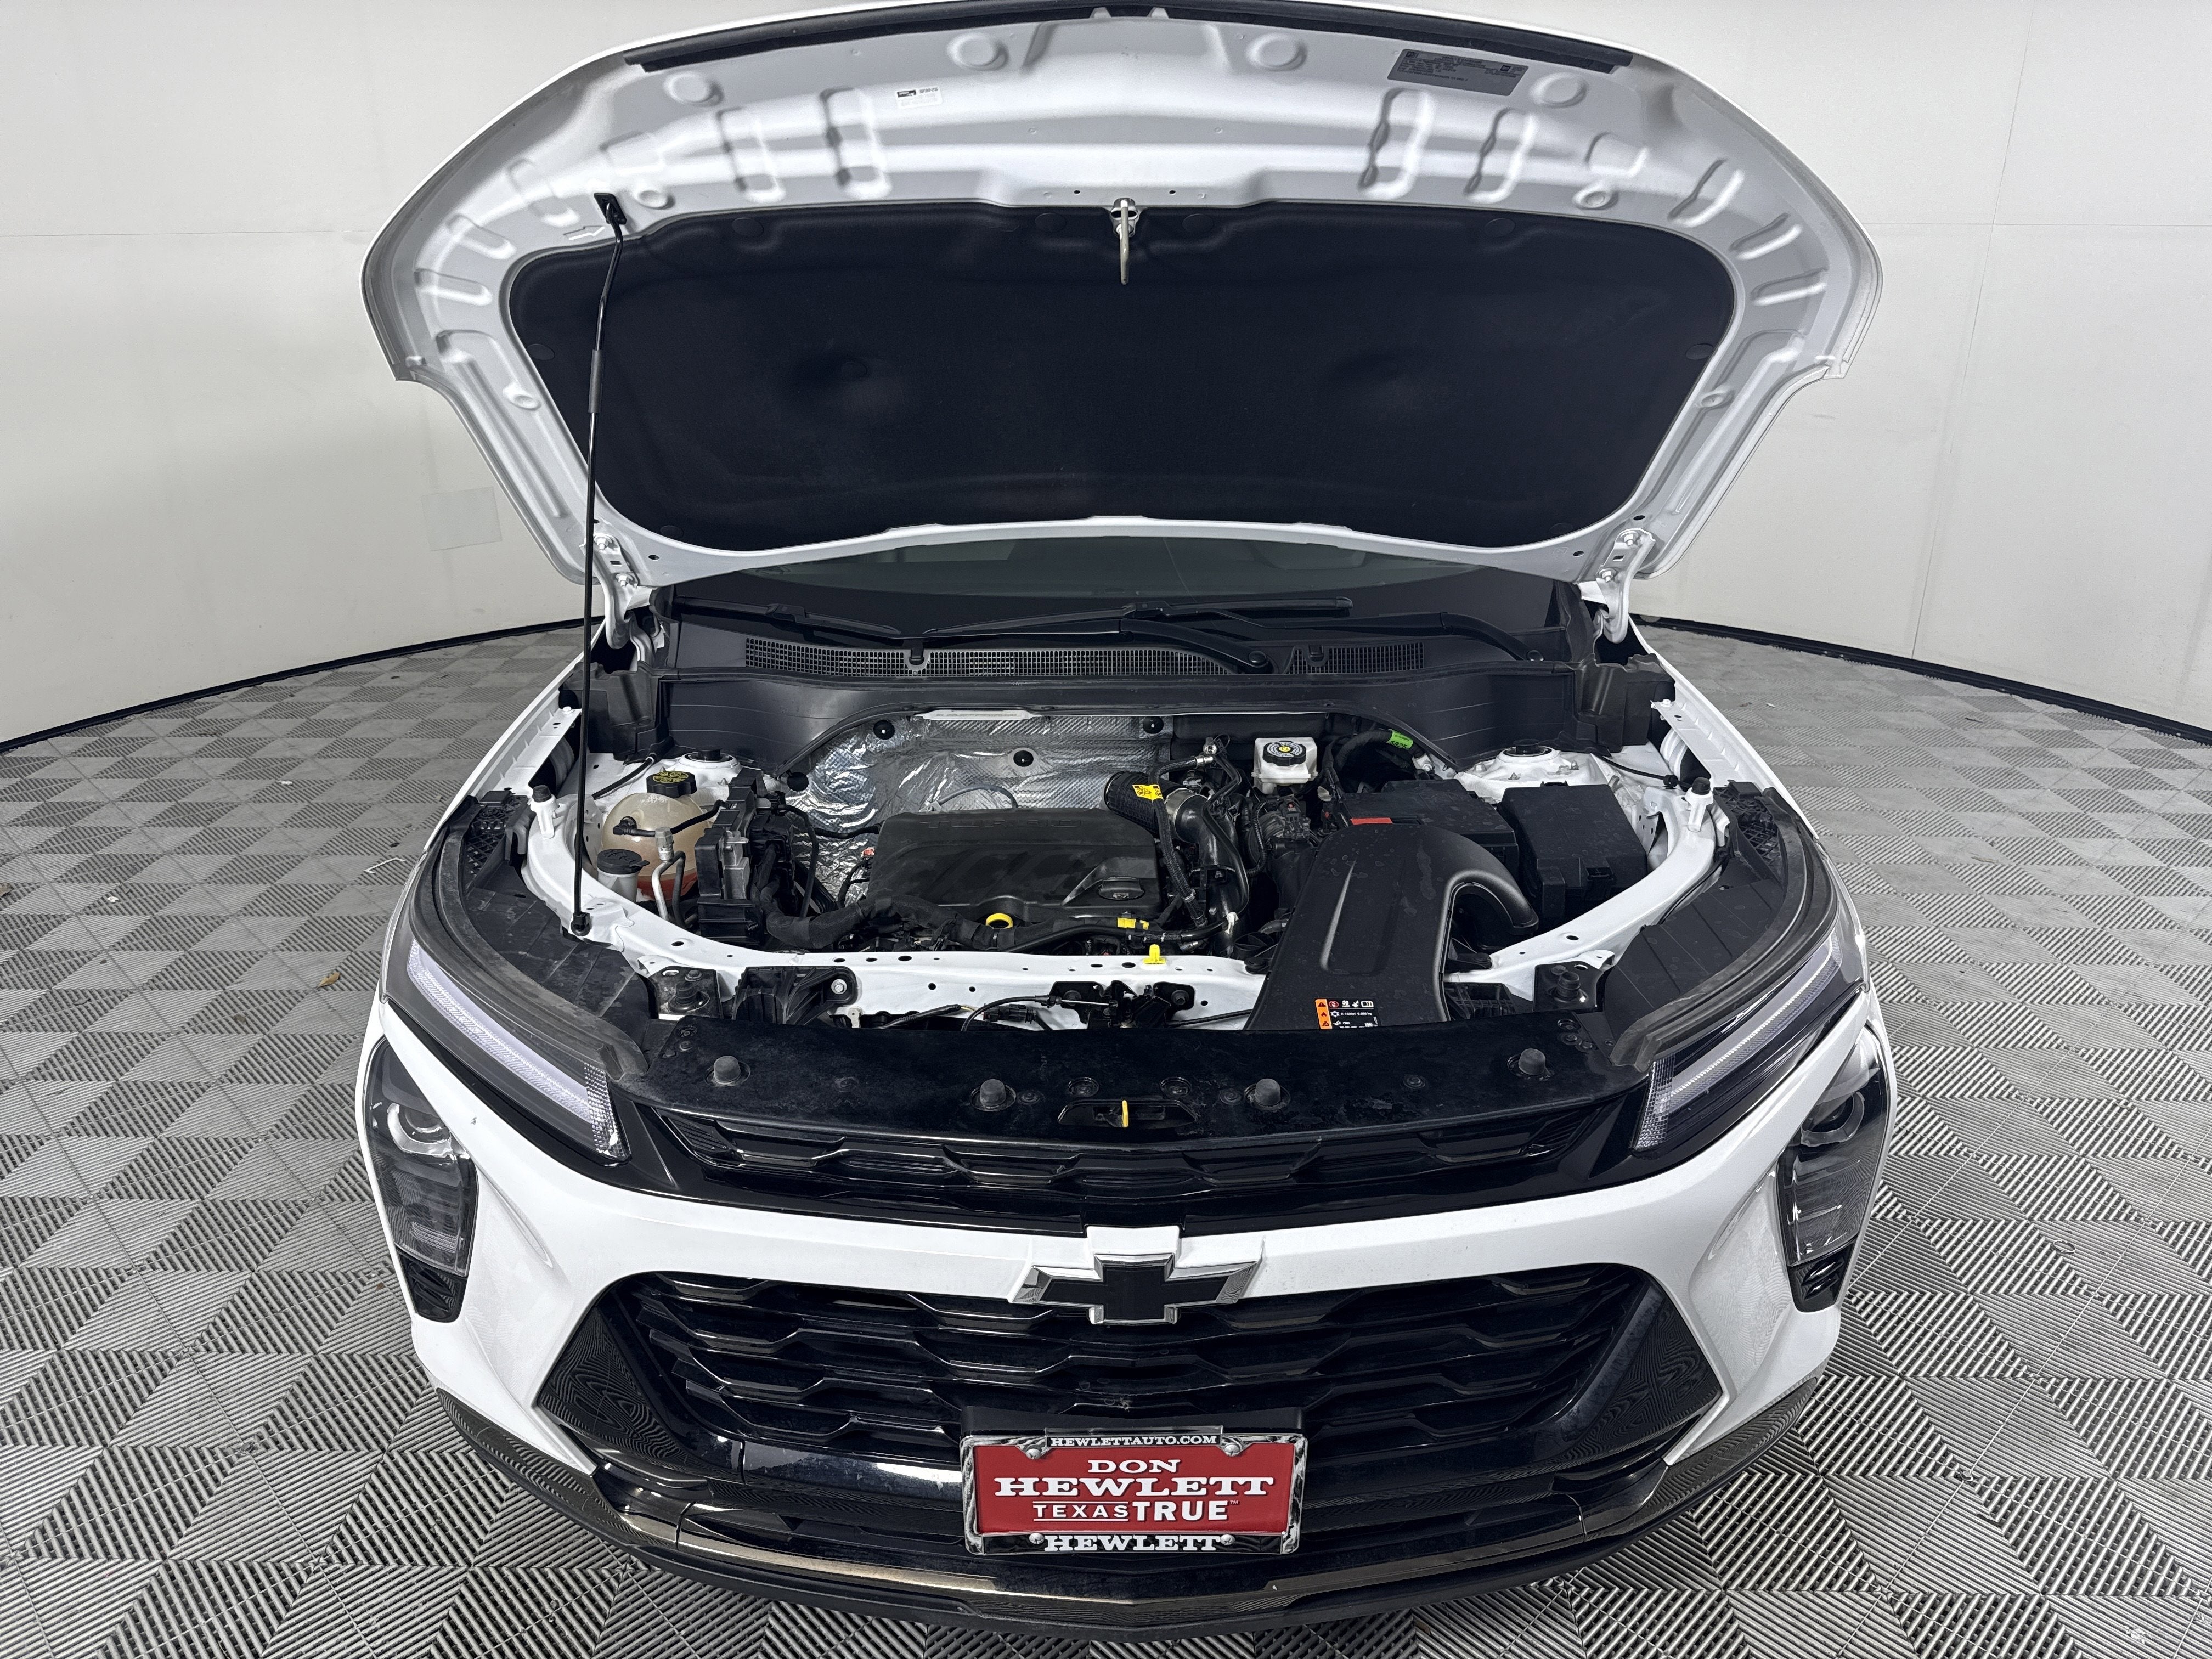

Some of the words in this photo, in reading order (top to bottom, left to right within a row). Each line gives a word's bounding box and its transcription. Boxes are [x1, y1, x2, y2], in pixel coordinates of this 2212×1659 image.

[919, 820, 1081, 828] TURBO
[1051, 1435, 1217, 1446] HEWLETTAUTO.COM
[1087, 1459, 1181, 1473] DON
[994, 1477, 1274, 1496] HEWLETT
[1044, 1535, 1220, 1551] HEWLETT
